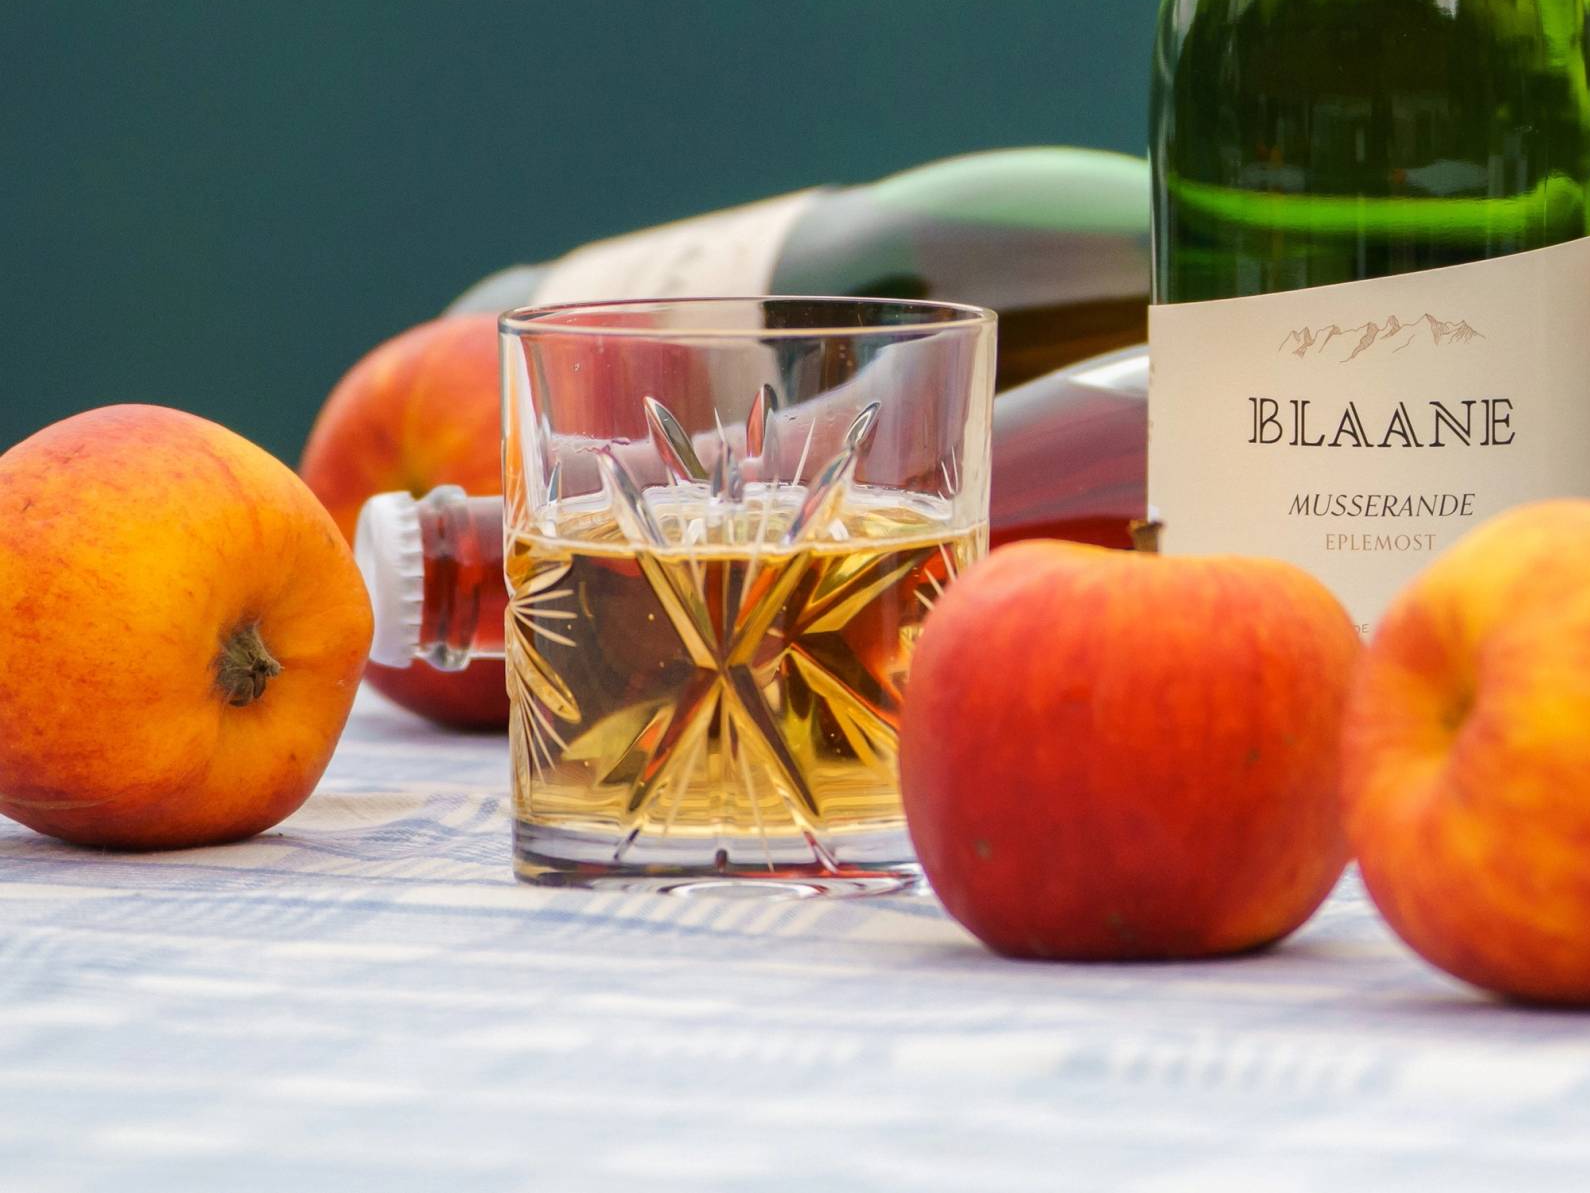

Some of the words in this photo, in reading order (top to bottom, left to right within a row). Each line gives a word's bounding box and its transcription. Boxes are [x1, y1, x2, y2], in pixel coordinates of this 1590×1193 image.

[1248, 397, 1515, 448] BLAANE
[1288, 493, 1475, 517] MUSSERANDE
[1326, 534, 1436, 551] EPLEMOST
